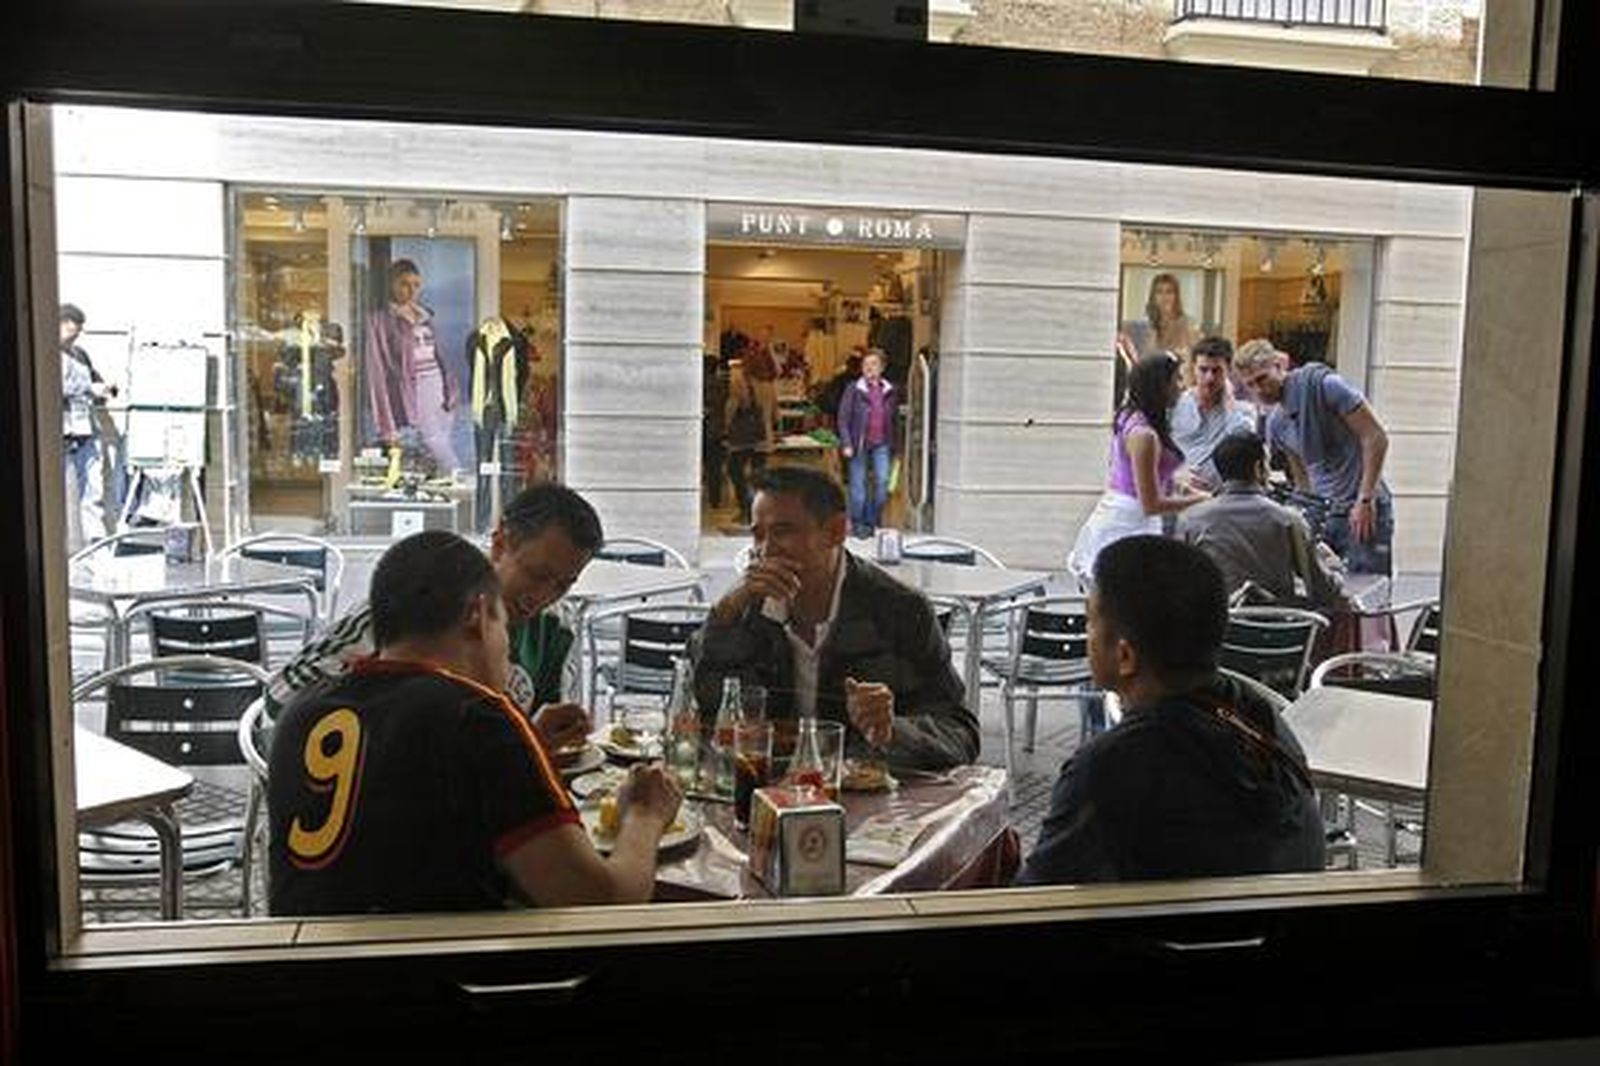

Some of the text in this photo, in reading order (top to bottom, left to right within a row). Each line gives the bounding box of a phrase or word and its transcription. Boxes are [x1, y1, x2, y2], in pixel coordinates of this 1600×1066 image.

[741, 213, 933, 239] PUNT ROMA
[287, 707, 364, 866] 9
